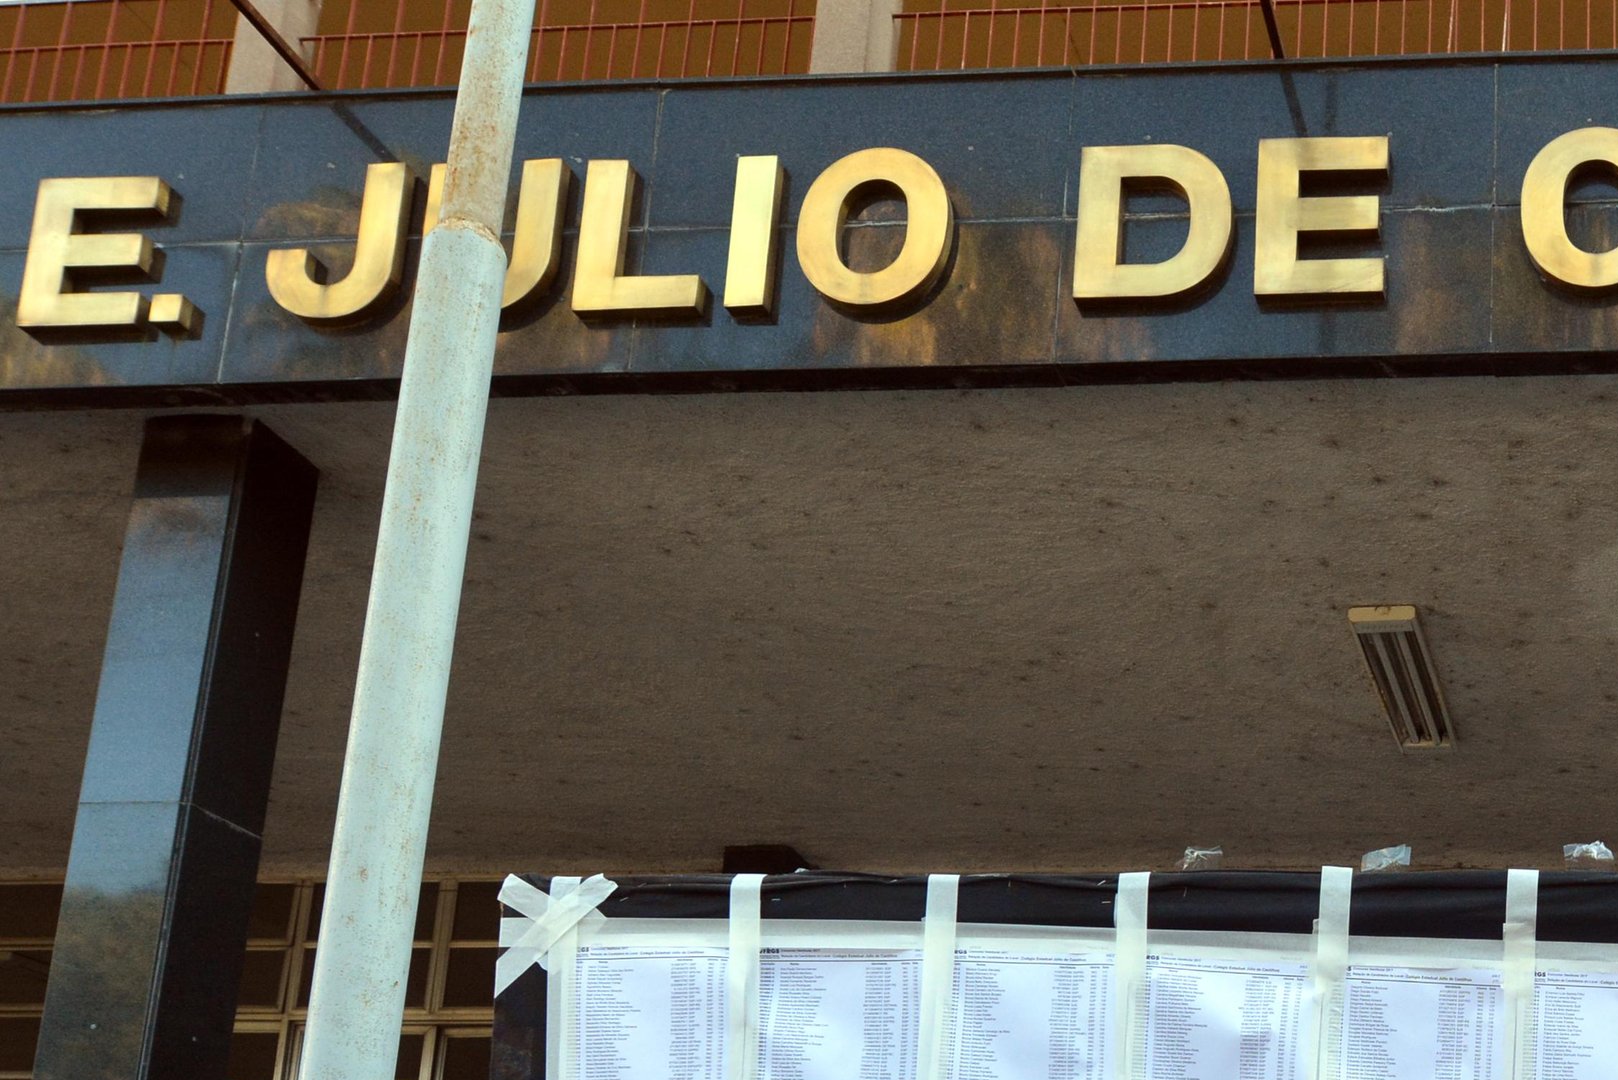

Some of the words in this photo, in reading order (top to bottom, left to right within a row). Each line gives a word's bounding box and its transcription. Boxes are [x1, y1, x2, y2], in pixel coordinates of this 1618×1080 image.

[16, 175, 196, 333] E.
[265, 146, 956, 322] JULIO
[1072, 135, 1390, 308] DE
